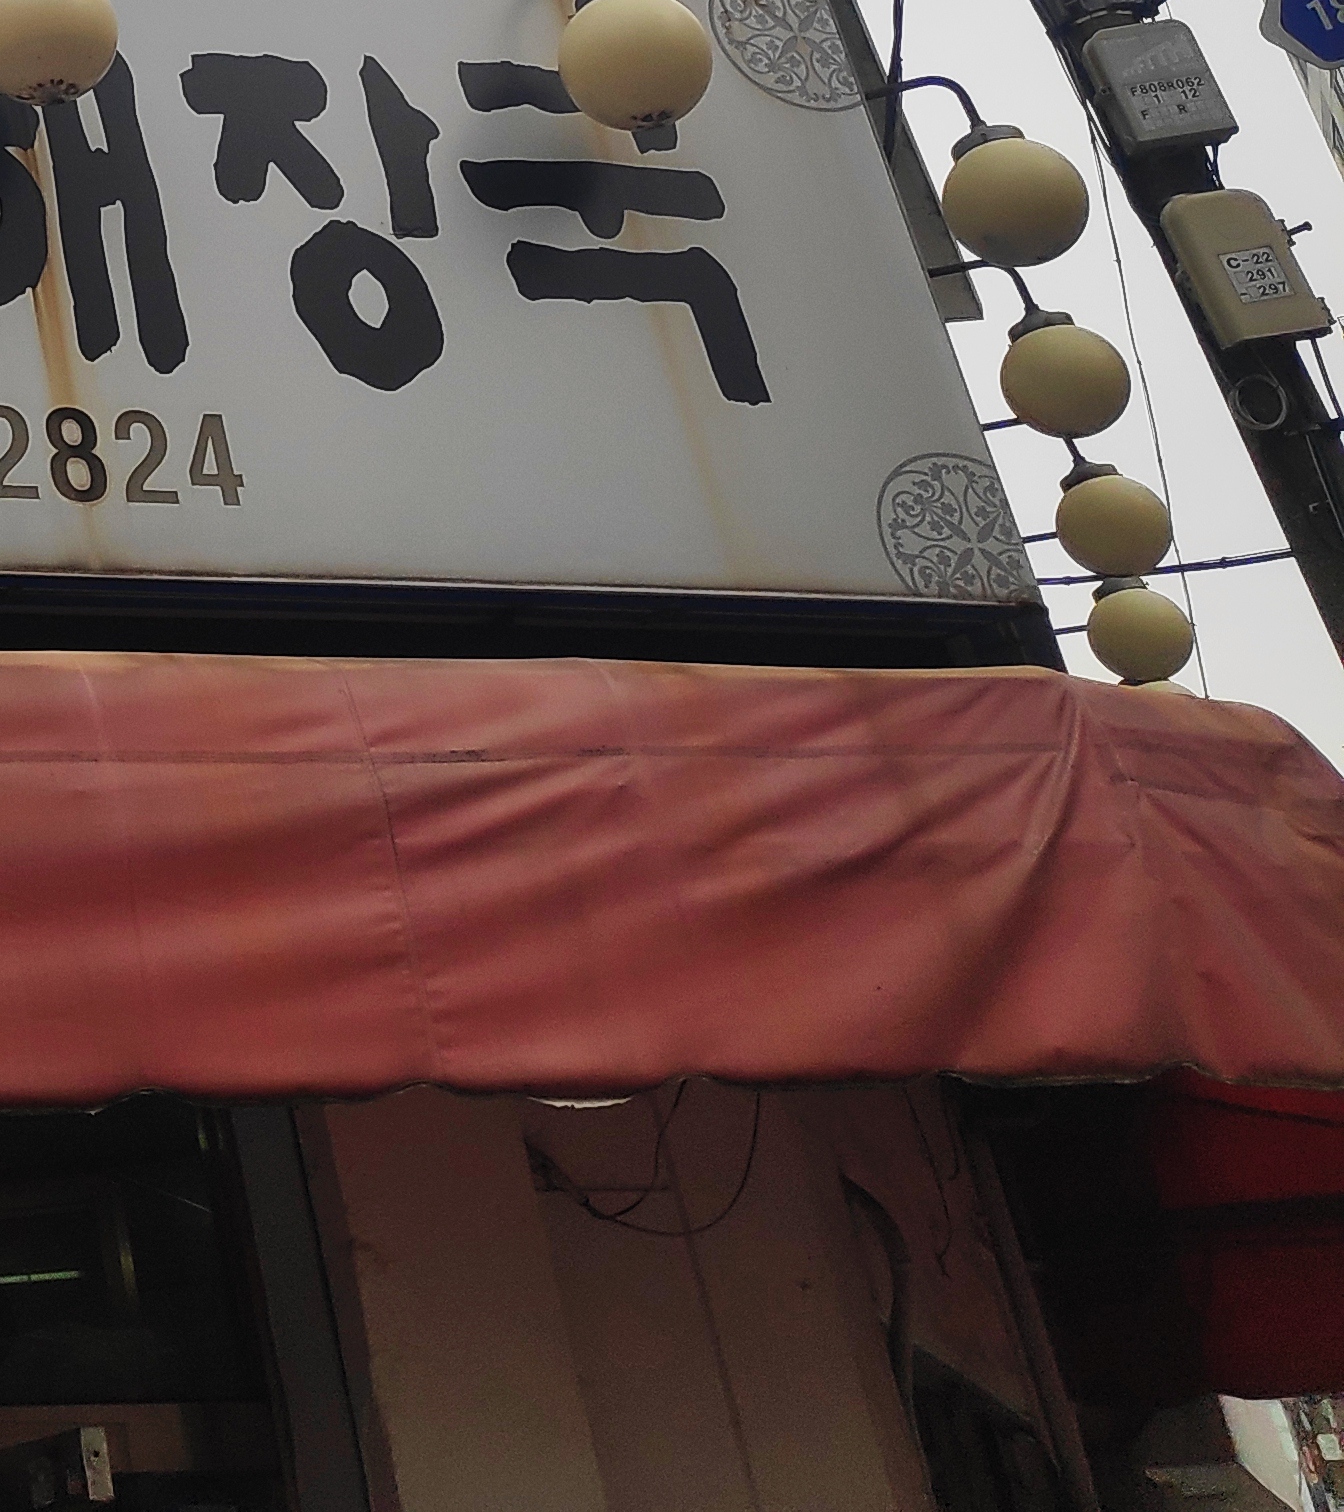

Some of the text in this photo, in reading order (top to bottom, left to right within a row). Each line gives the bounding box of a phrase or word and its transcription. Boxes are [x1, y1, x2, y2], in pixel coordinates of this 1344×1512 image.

[1130, 76, 1205, 97] F808R062
[1141, 104, 1188, 120] F R
[1226, 252, 1273, 269] C-22
[1246, 268, 1276, 282] 291
